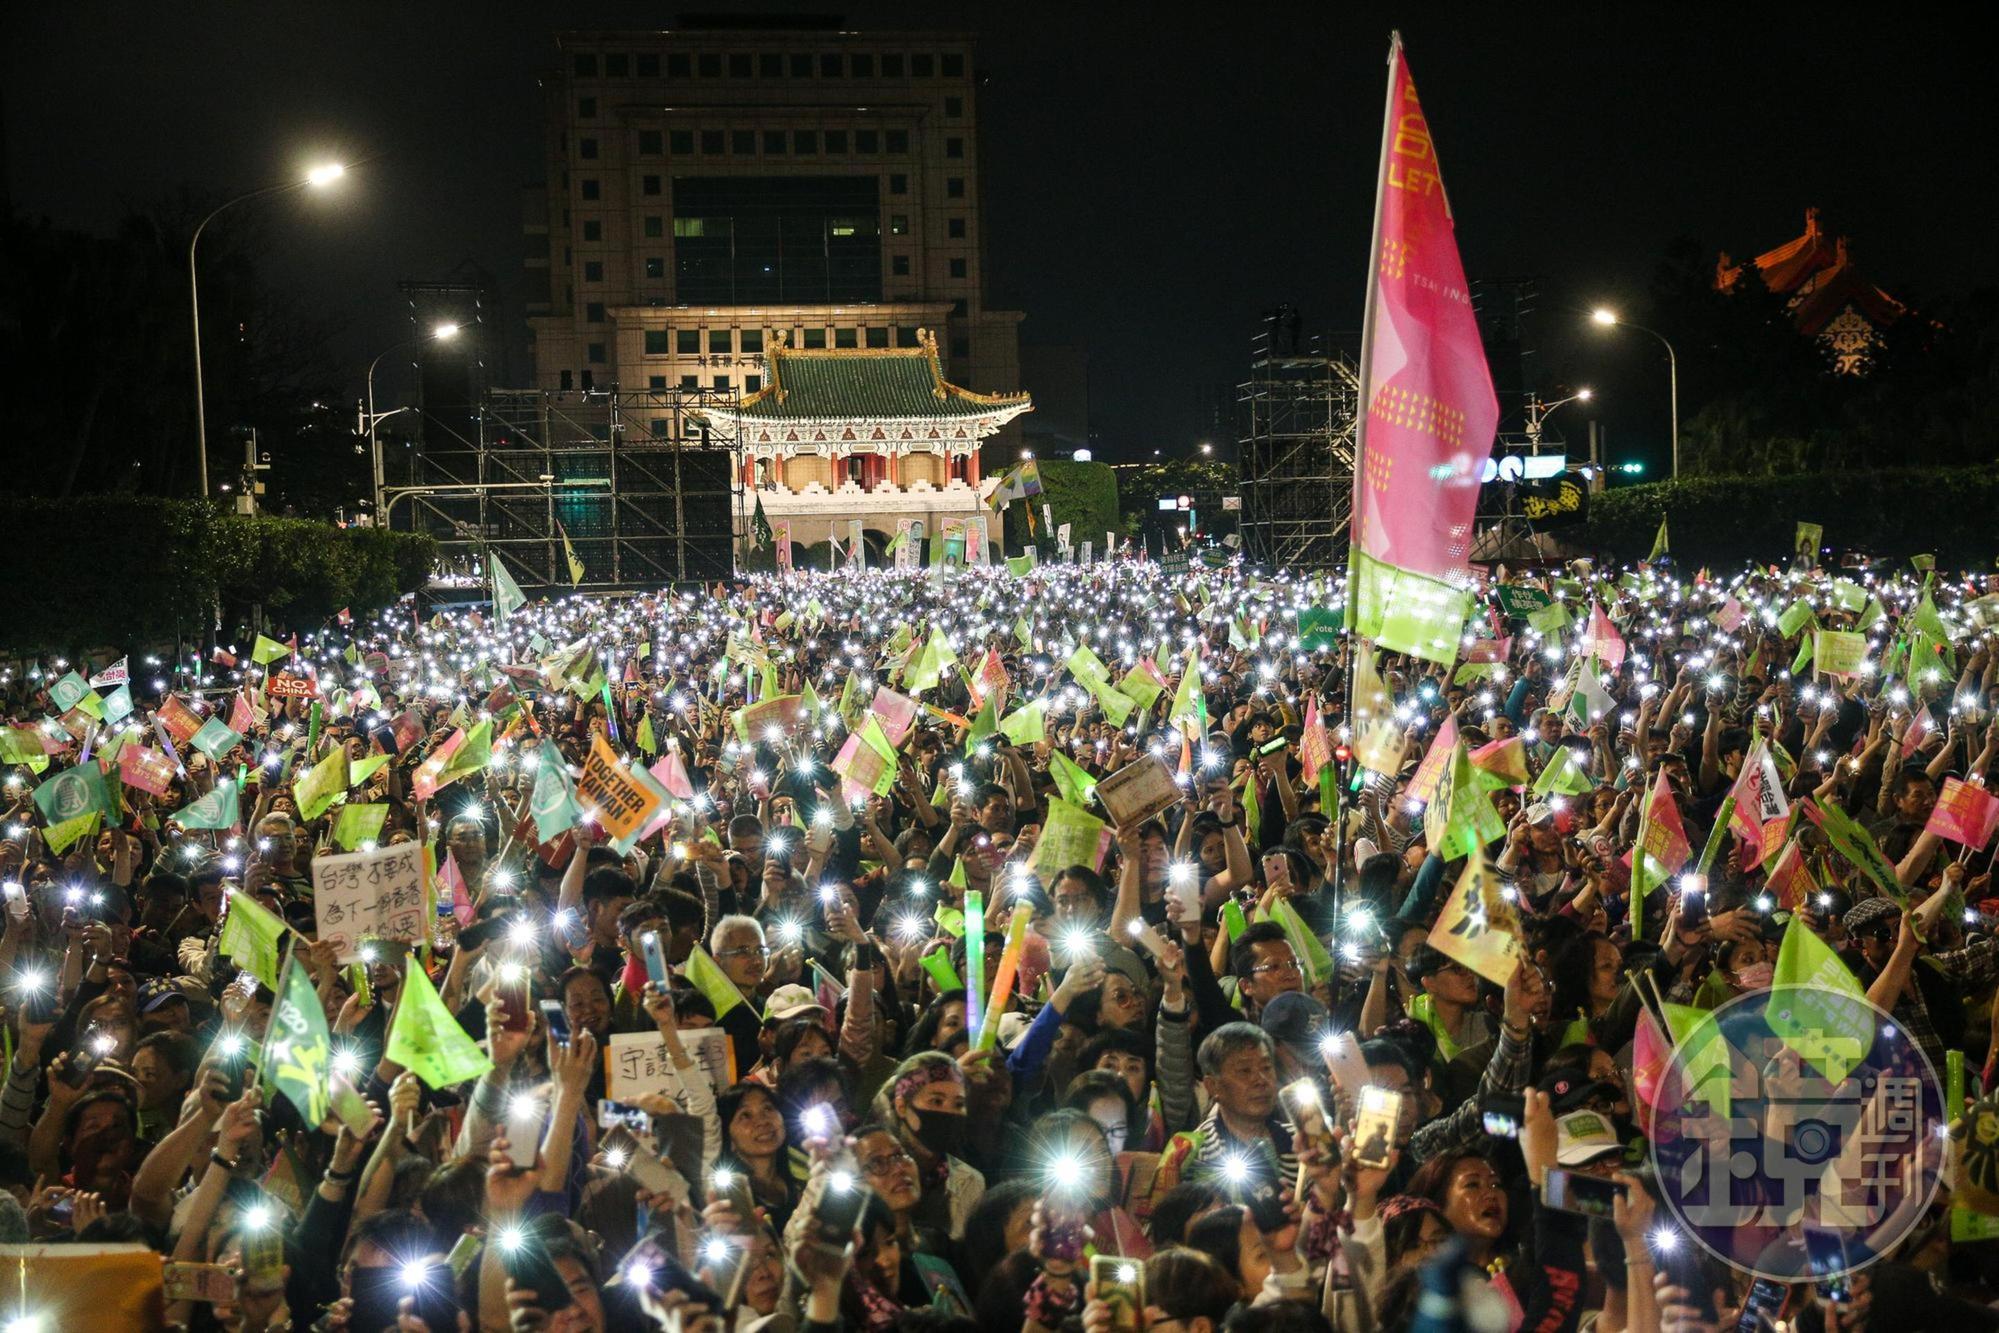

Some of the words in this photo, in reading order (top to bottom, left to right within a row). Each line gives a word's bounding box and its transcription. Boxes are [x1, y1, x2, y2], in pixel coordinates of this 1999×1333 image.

[1413, 273, 1438, 293] TSAI
[1314, 625, 1333, 633] vote
[272, 686, 312, 696] CHINA
[277, 679, 307, 689] NO
[588, 750, 645, 814] TOGETHER
[582, 769, 627, 821] TAIWAN
